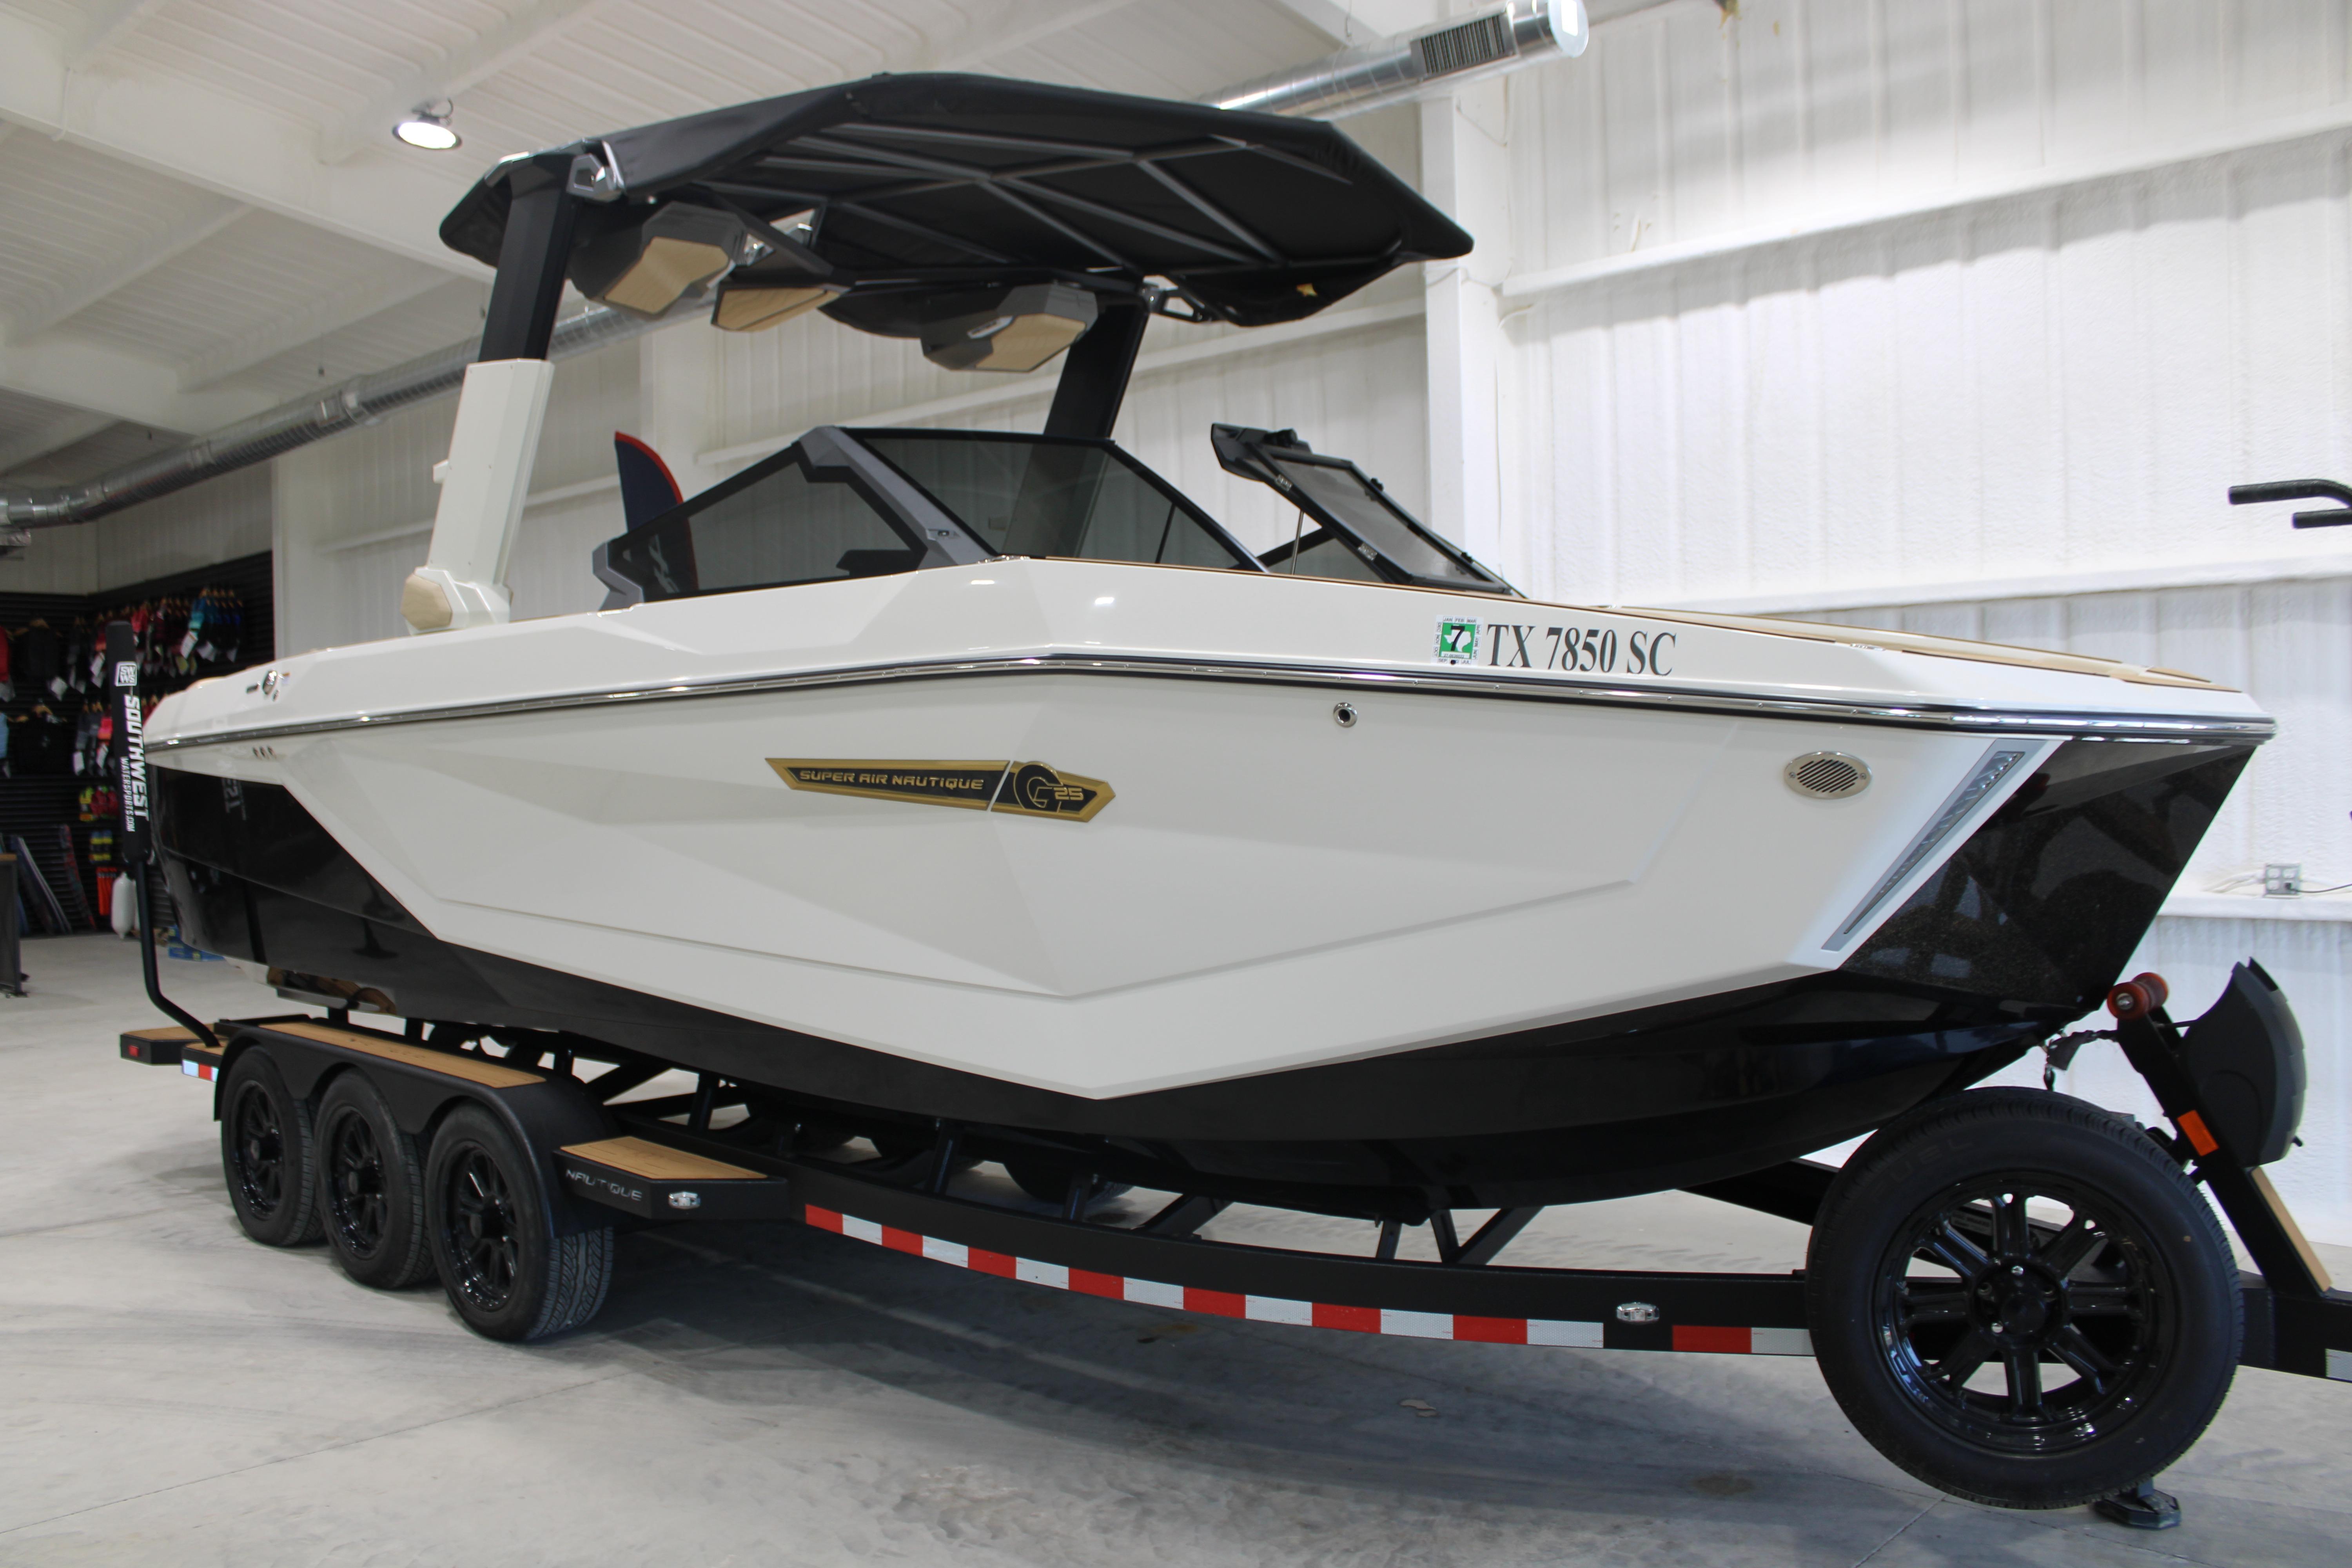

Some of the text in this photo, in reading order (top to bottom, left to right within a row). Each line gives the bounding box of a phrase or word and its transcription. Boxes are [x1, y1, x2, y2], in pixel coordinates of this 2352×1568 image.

[1451, 625, 1465, 652] 7
[1487, 624, 1677, 676] TX 7850 SC
[123, 693, 149, 822] SOUTHWEST
[120, 757, 136, 832] WATERSPORTS.COM
[800, 770, 984, 790] SUPER AIR NAUTIQUE
[565, 1169, 643, 1202] NAUTIQUE
